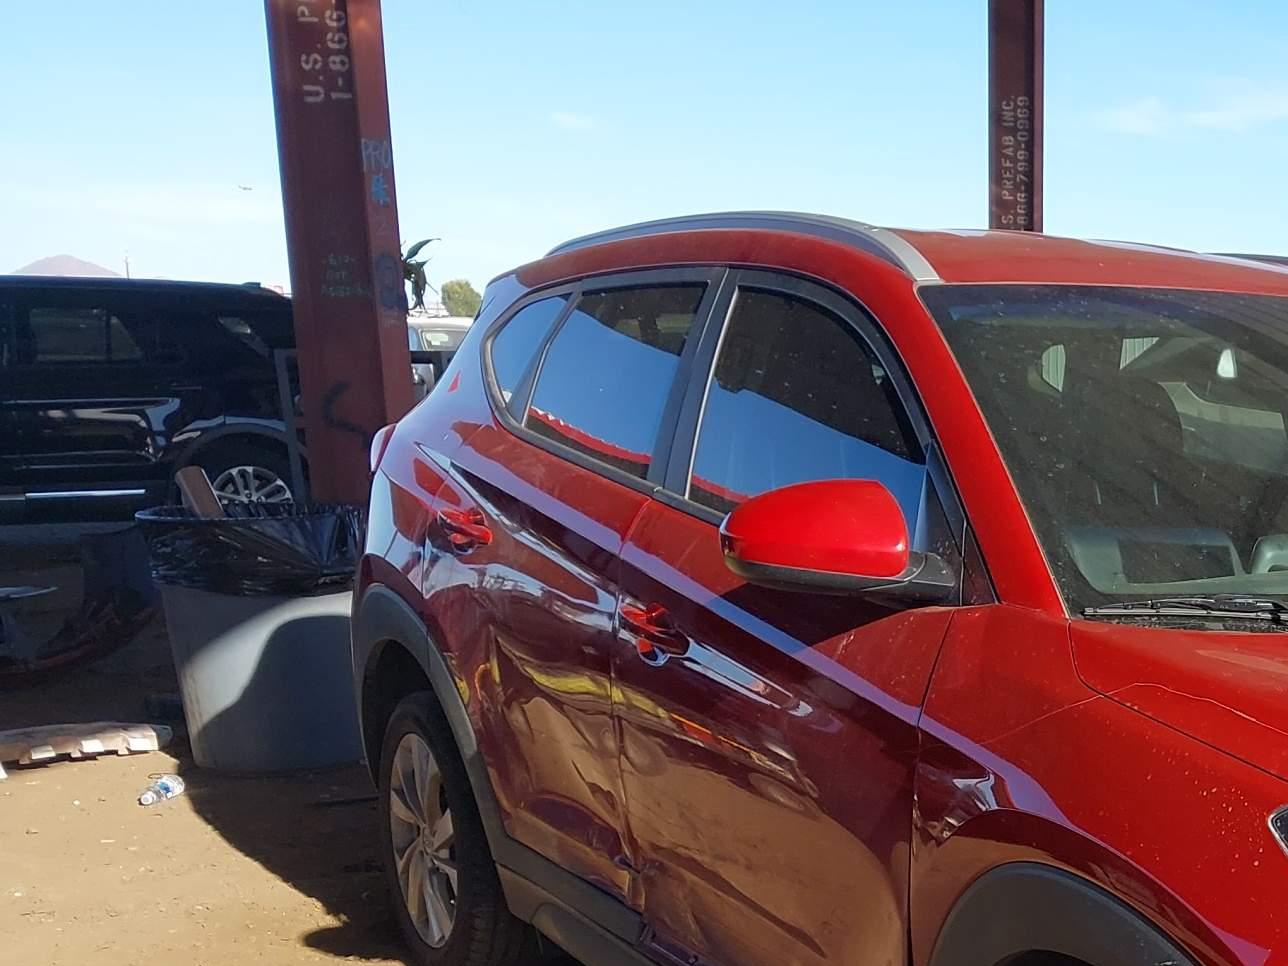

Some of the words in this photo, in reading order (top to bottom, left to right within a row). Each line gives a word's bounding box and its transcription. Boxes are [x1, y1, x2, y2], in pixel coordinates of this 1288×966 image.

[296, 0, 319, 22] P
[300, 44, 325, 103] U.S.
[1001, 95, 1015, 127] INC.
[1001, 135, 1015, 201] PREFAB
[1016, 95, 1030, 232] -866-799-0969
